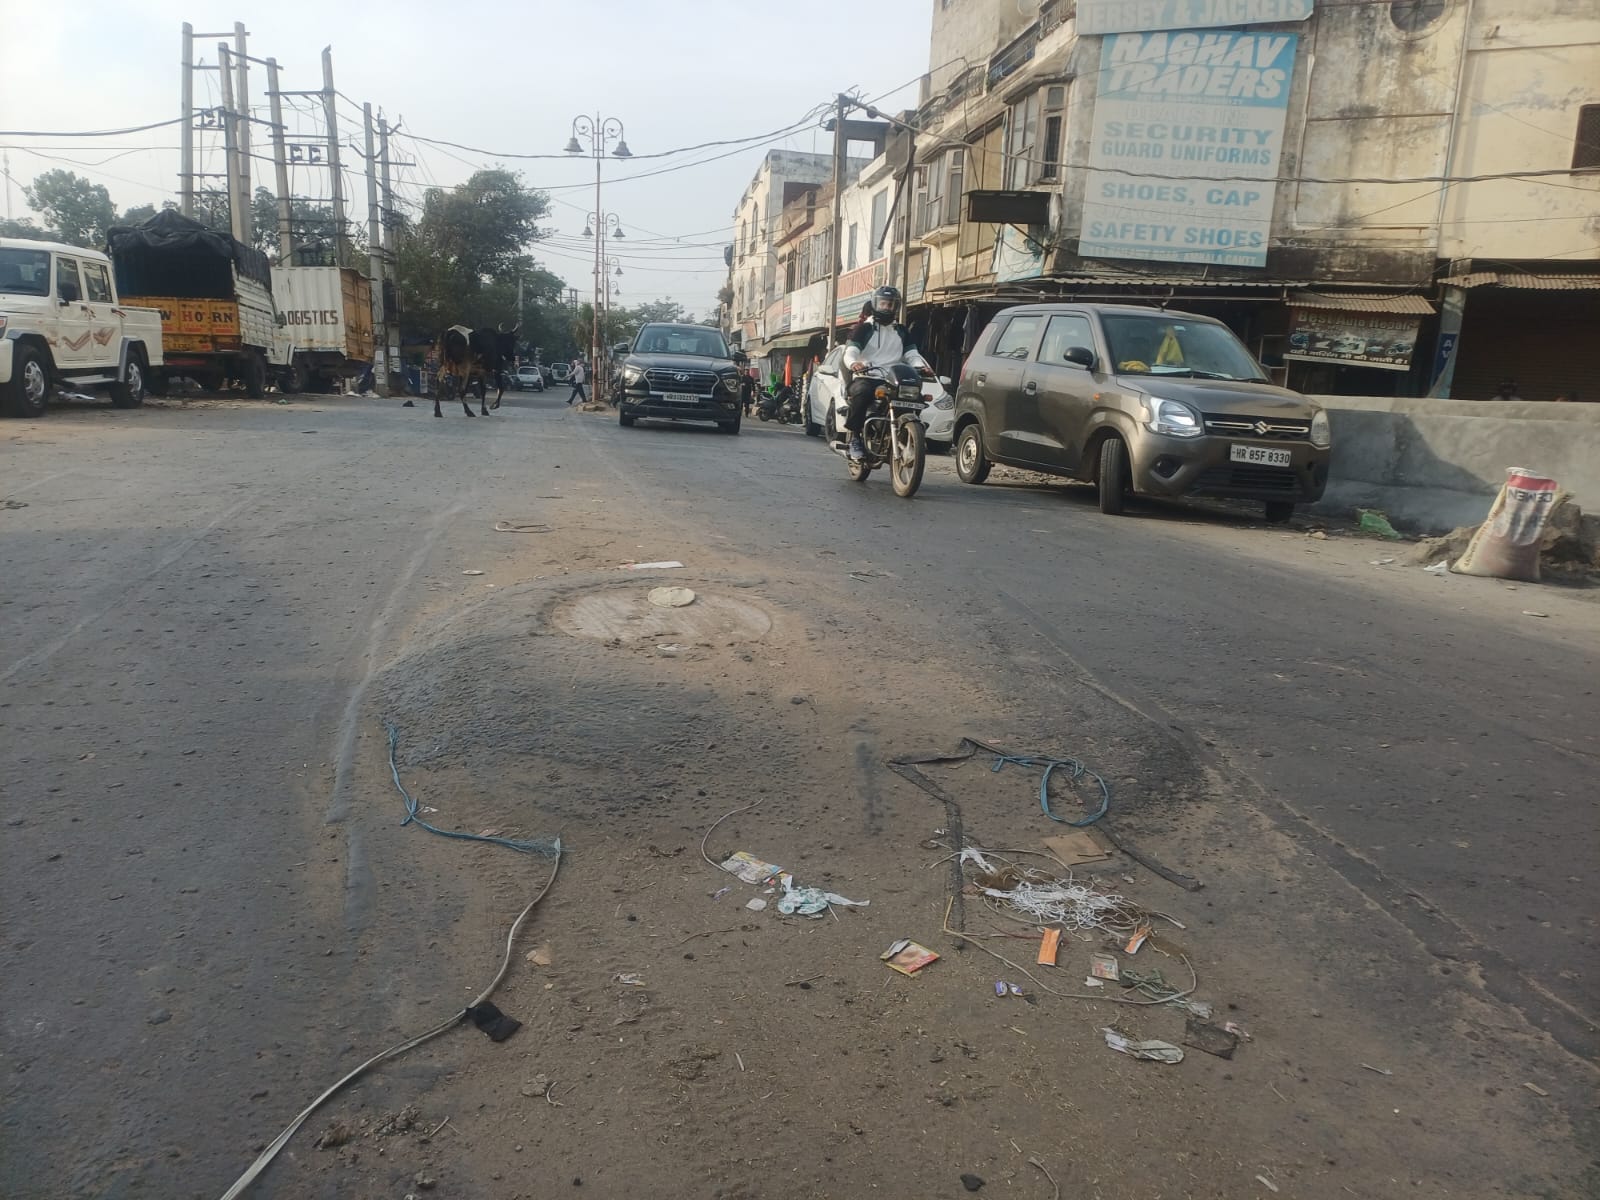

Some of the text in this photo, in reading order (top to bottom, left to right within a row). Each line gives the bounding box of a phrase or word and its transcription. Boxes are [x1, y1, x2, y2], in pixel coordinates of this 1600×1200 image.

[1088, 1, 1165, 32] JERSEY
[1201, 0, 1305, 23] JACKETS
[1110, 32, 1290, 68] RAGHAV
[1107, 64, 1286, 98] TRADERS
[1103, 121, 1273, 145] SECURITY
[1102, 140, 1271, 166] GUARD UNIFORMS
[1101, 182, 1260, 207] SHOES, CAP
[1089, 221, 1263, 249] SAFETY SHOES
[283, 310, 339, 326] OGISTICS
[1297, 311, 1333, 325] Best
[1268, 451, 1290, 464] 8330
